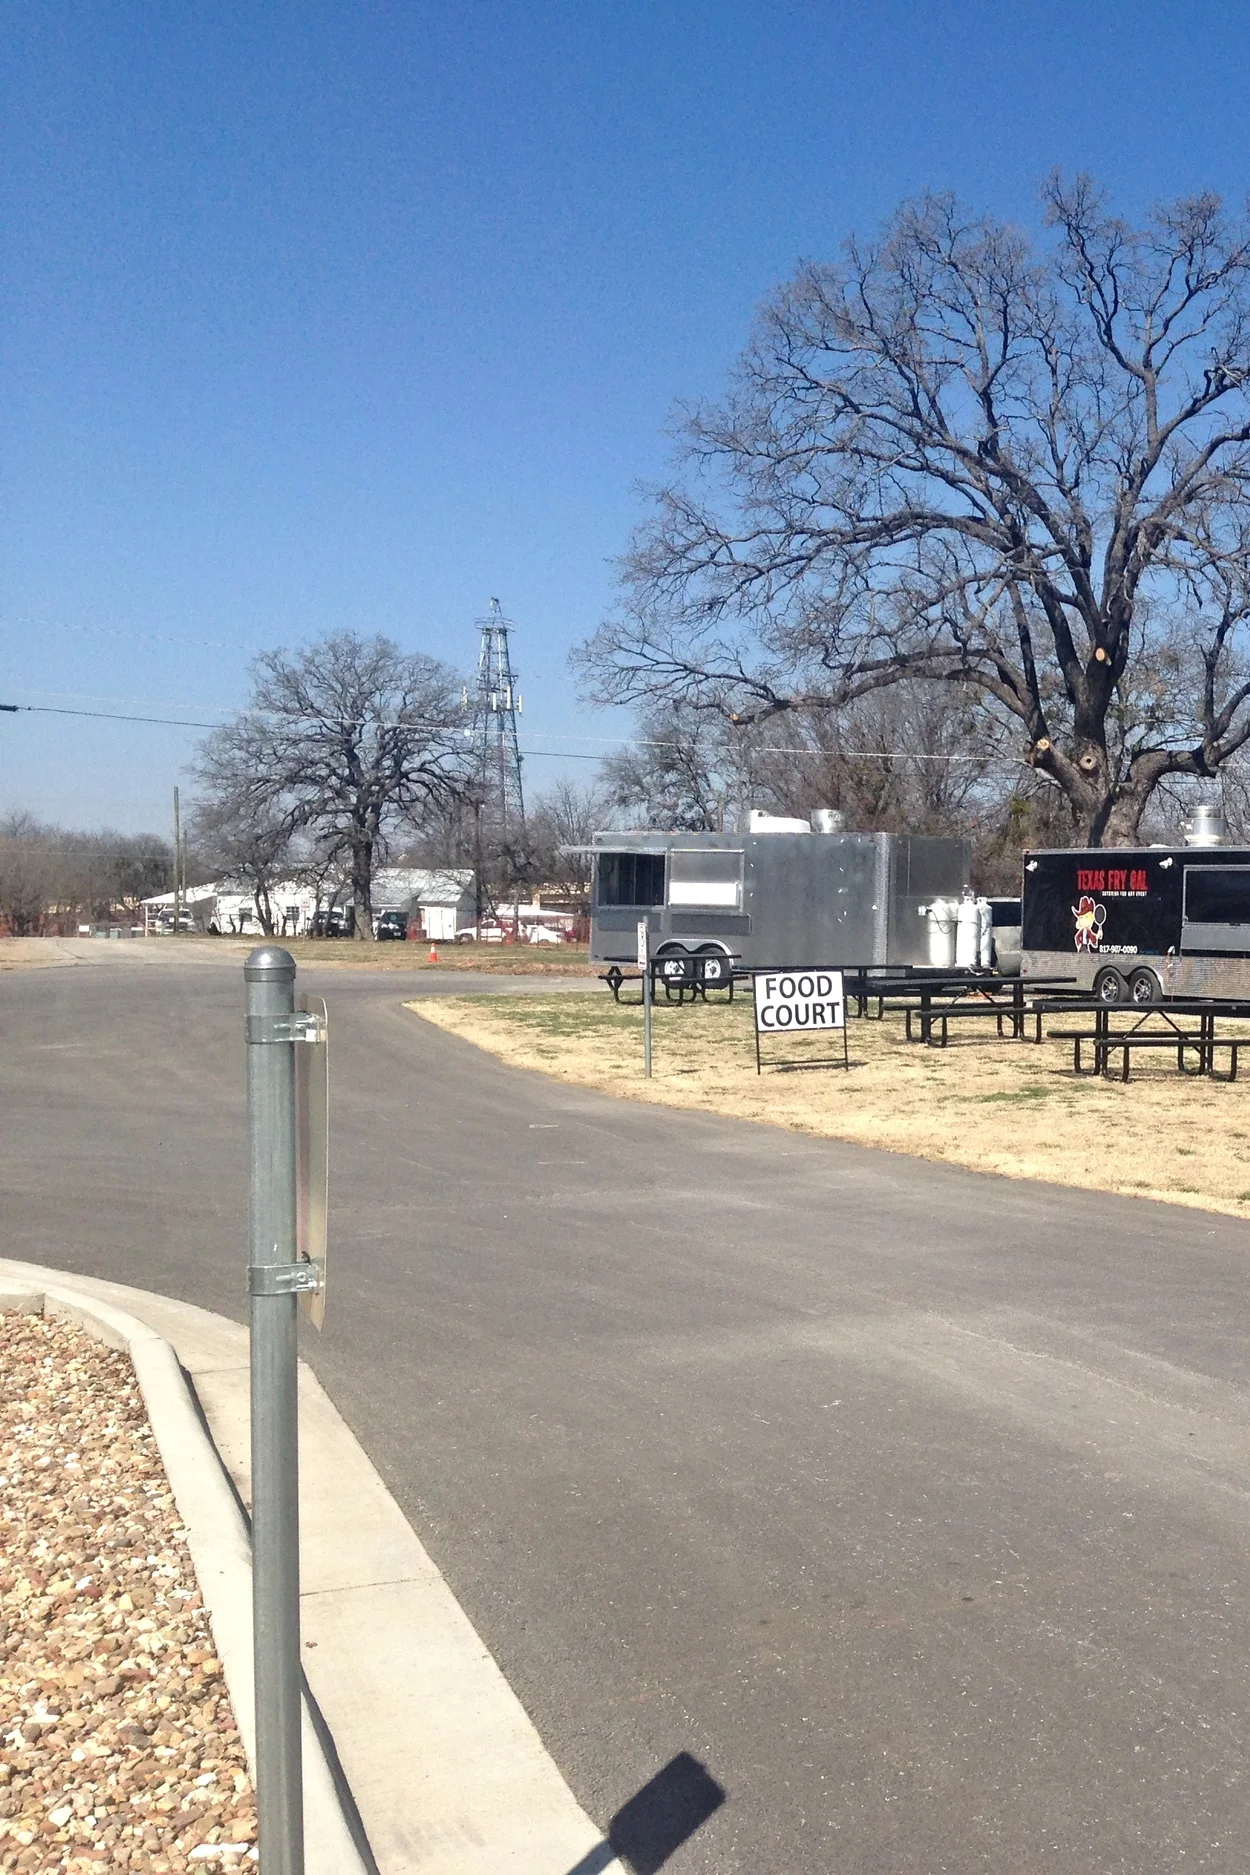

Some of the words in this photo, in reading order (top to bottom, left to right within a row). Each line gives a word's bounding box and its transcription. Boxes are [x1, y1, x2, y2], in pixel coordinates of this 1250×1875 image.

[1077, 870, 1105, 890] TEXAS
[1108, 870, 1127, 890] FRY
[1130, 870, 1148, 890] GAL
[765, 975, 832, 999] FOOD
[761, 1002, 840, 1027] COURT
